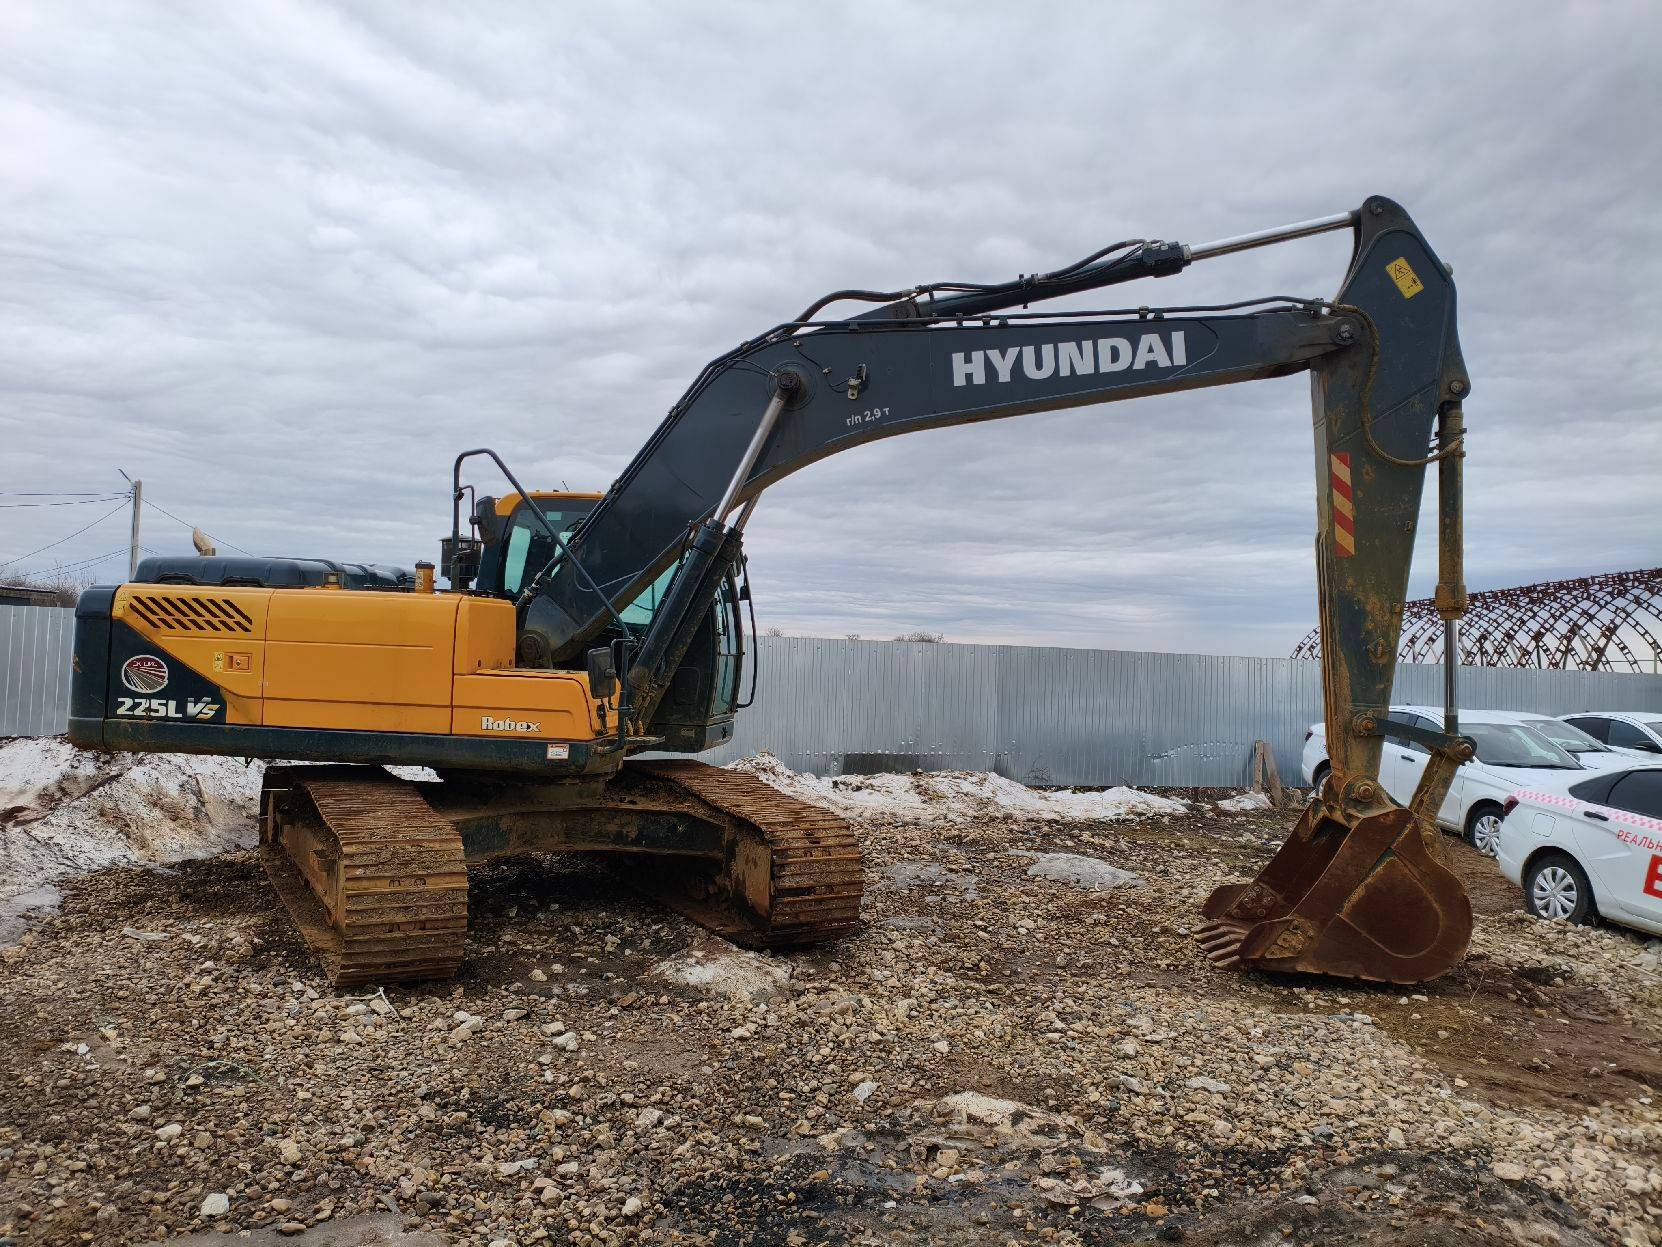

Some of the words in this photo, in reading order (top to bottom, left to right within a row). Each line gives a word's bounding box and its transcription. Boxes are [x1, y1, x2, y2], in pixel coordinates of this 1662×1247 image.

[952, 331, 1187, 387] HYUNDAI
[846, 413, 862, 426] г/п
[864, 408, 882, 421] 2,9
[116, 697, 183, 718] 225L
[481, 716, 542, 732] Robex
